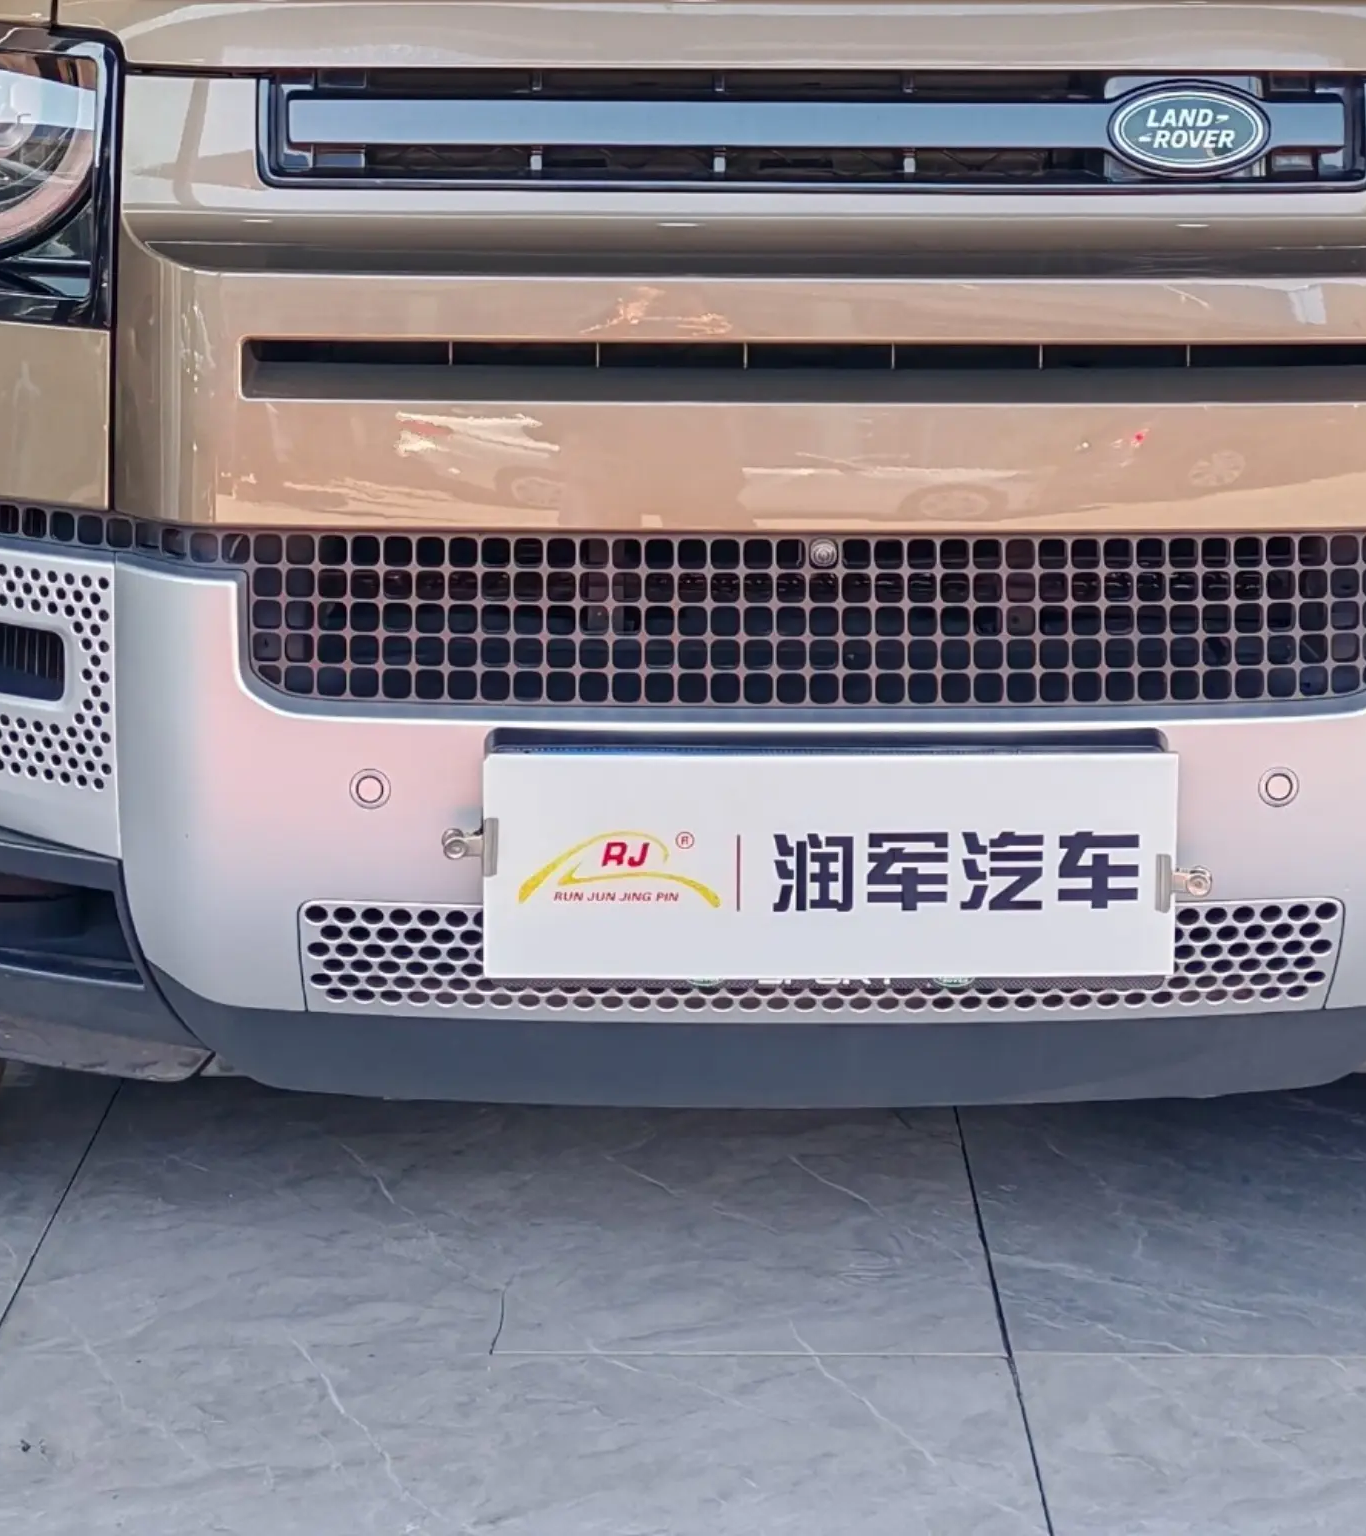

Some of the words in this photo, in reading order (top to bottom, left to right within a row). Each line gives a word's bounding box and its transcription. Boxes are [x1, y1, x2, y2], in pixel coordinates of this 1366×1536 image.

[601, 841, 650, 869] RJ
[773, 831, 1140, 912] 润军汽车
[553, 891, 584, 902] RUN
[587, 891, 616, 902] JUN
[619, 891, 652, 902] JING
[656, 891, 680, 902] PIN
